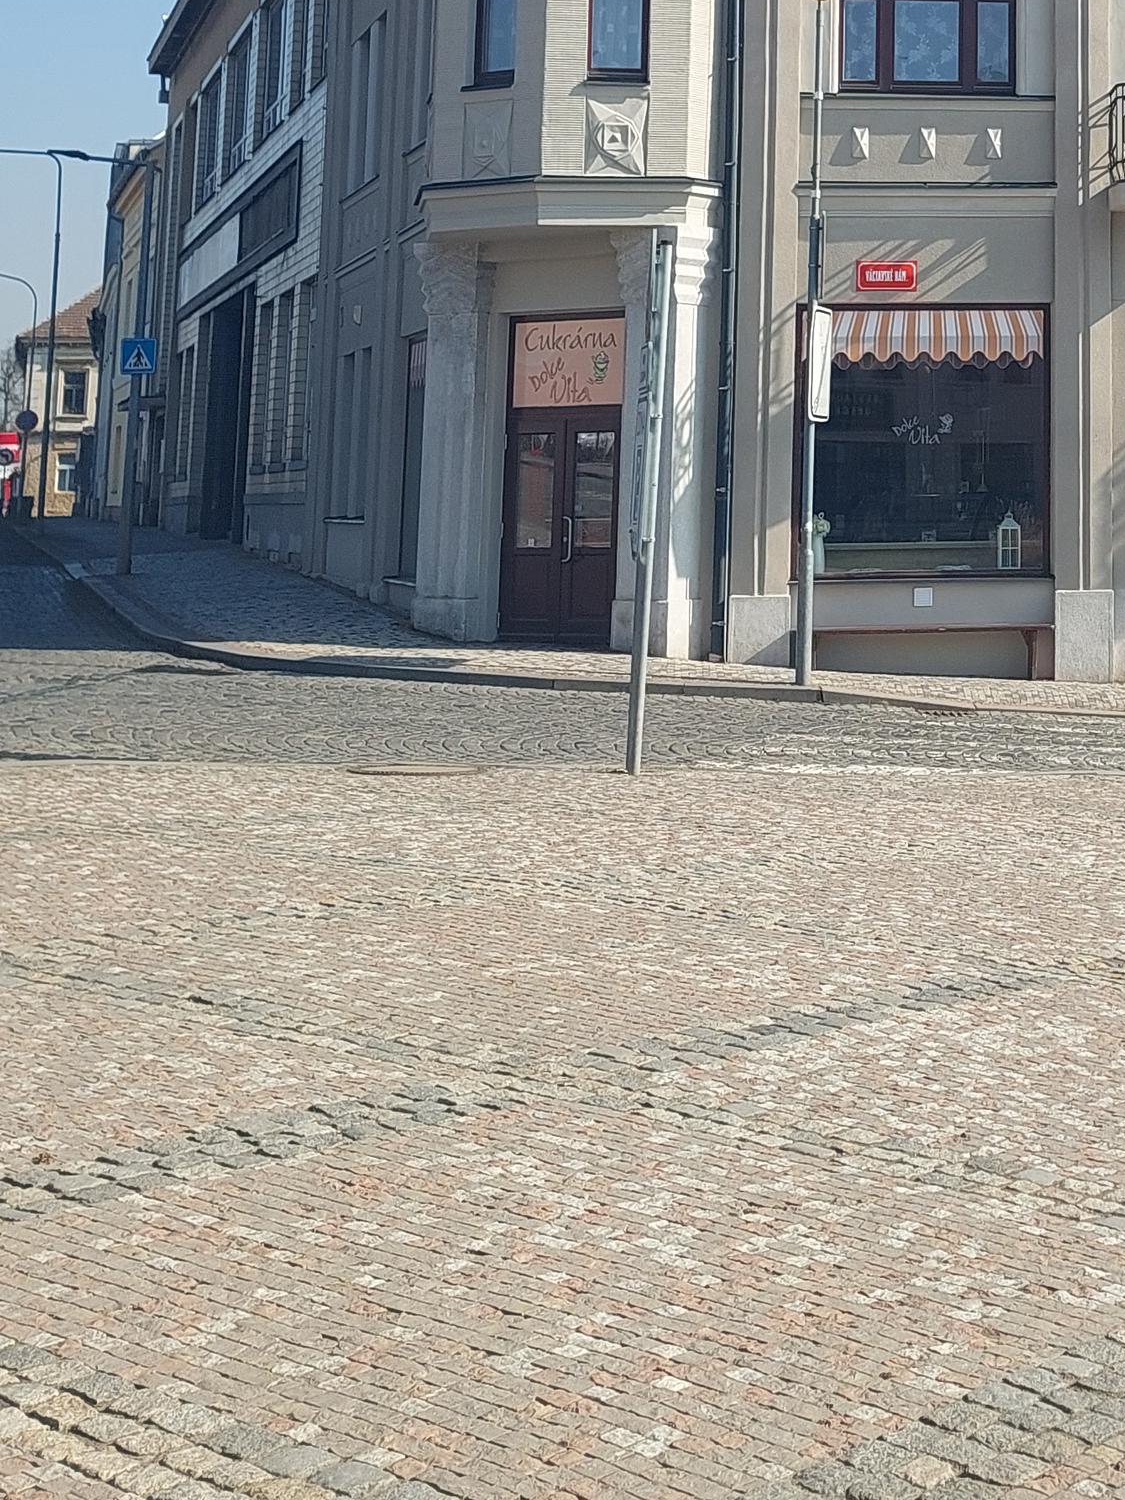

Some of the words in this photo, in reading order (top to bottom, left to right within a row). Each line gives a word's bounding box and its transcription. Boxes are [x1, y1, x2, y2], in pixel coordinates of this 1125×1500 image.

[525, 324, 617, 352] Cukrárna
[528, 357, 565, 393] Dolce
[550, 371, 592, 404] Vita
[891, 415, 920, 437] Dolce
[908, 425, 941, 445] Vita
